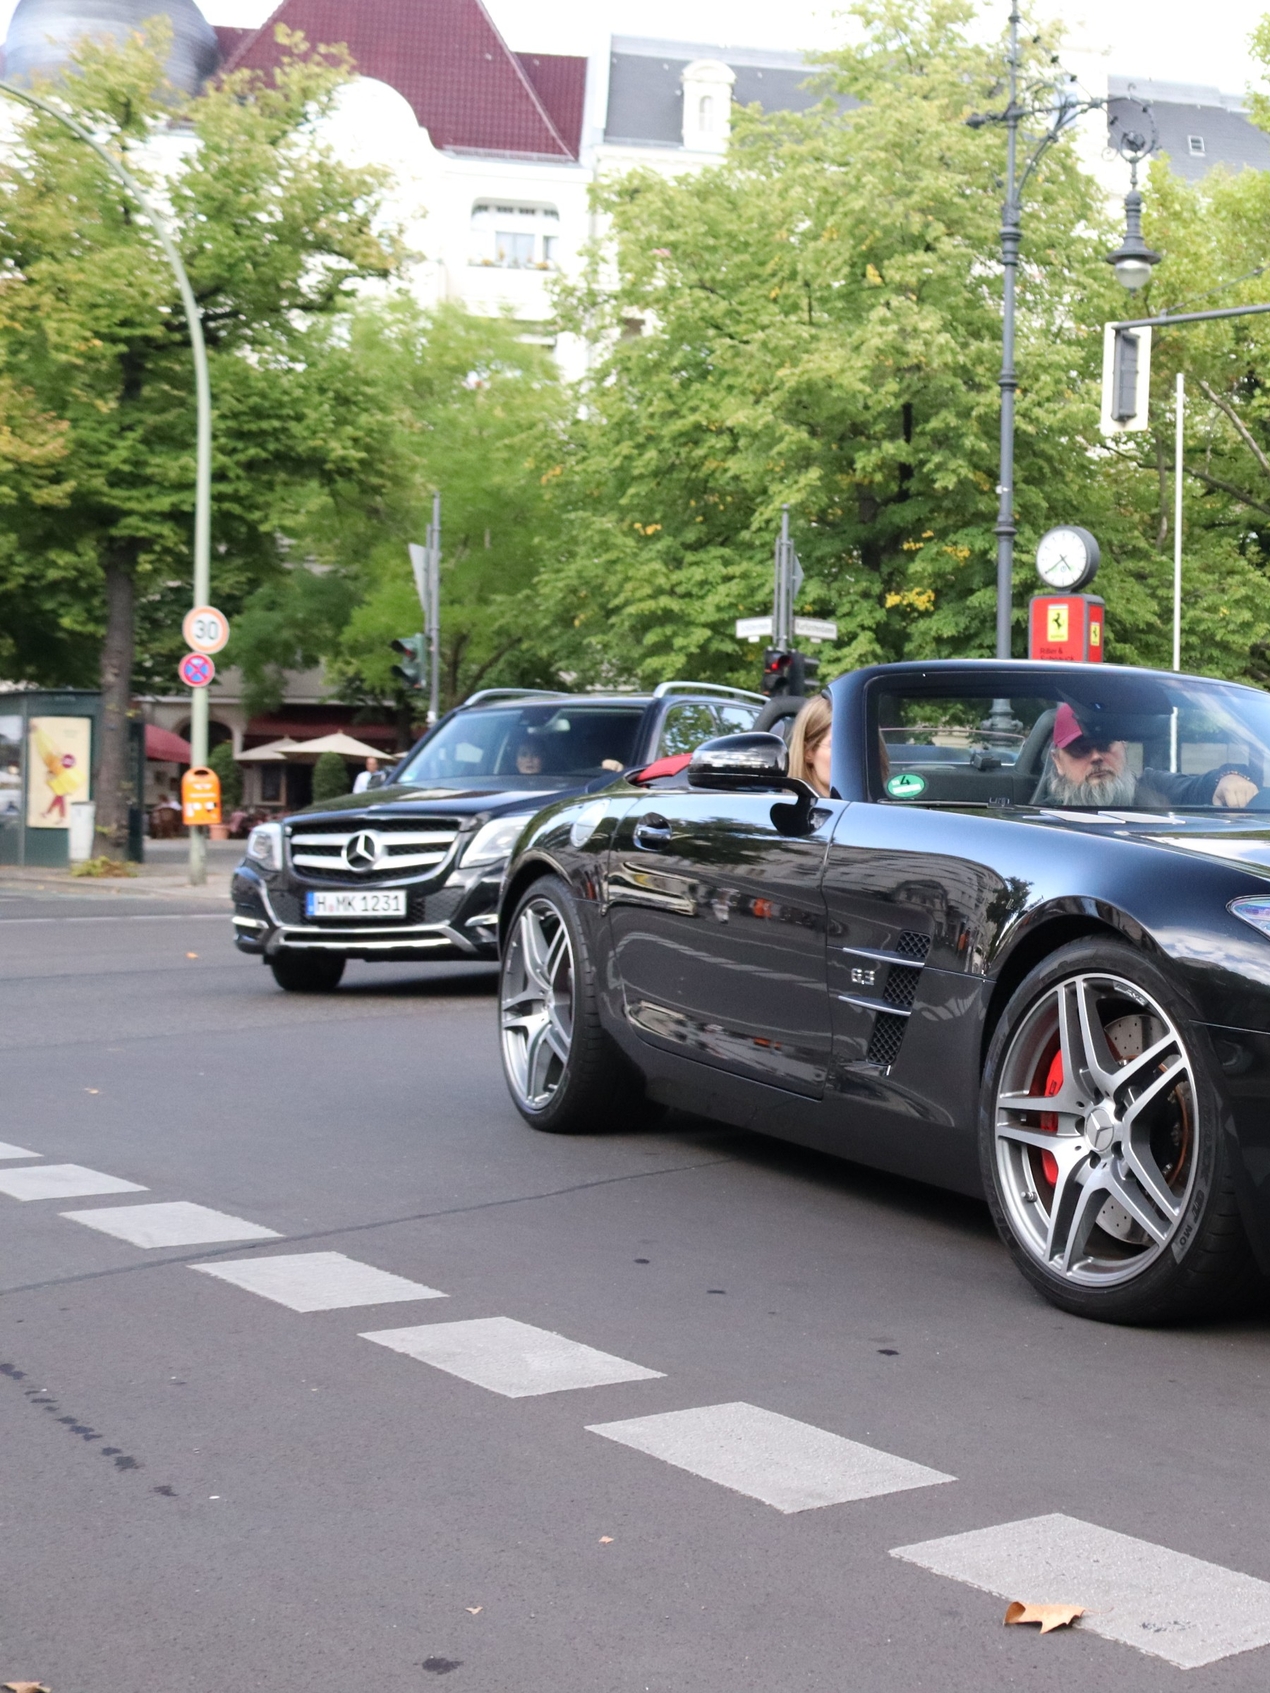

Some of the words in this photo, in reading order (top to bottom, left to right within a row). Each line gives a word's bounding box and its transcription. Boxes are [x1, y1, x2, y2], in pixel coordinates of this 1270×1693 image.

[195, 620, 218, 640] 30
[900, 776, 911, 785] 4
[316, 896, 326, 912] H
[336, 895, 356, 912] MK
[361, 895, 401, 912] 1231
[851, 968, 875, 985] 6.3
